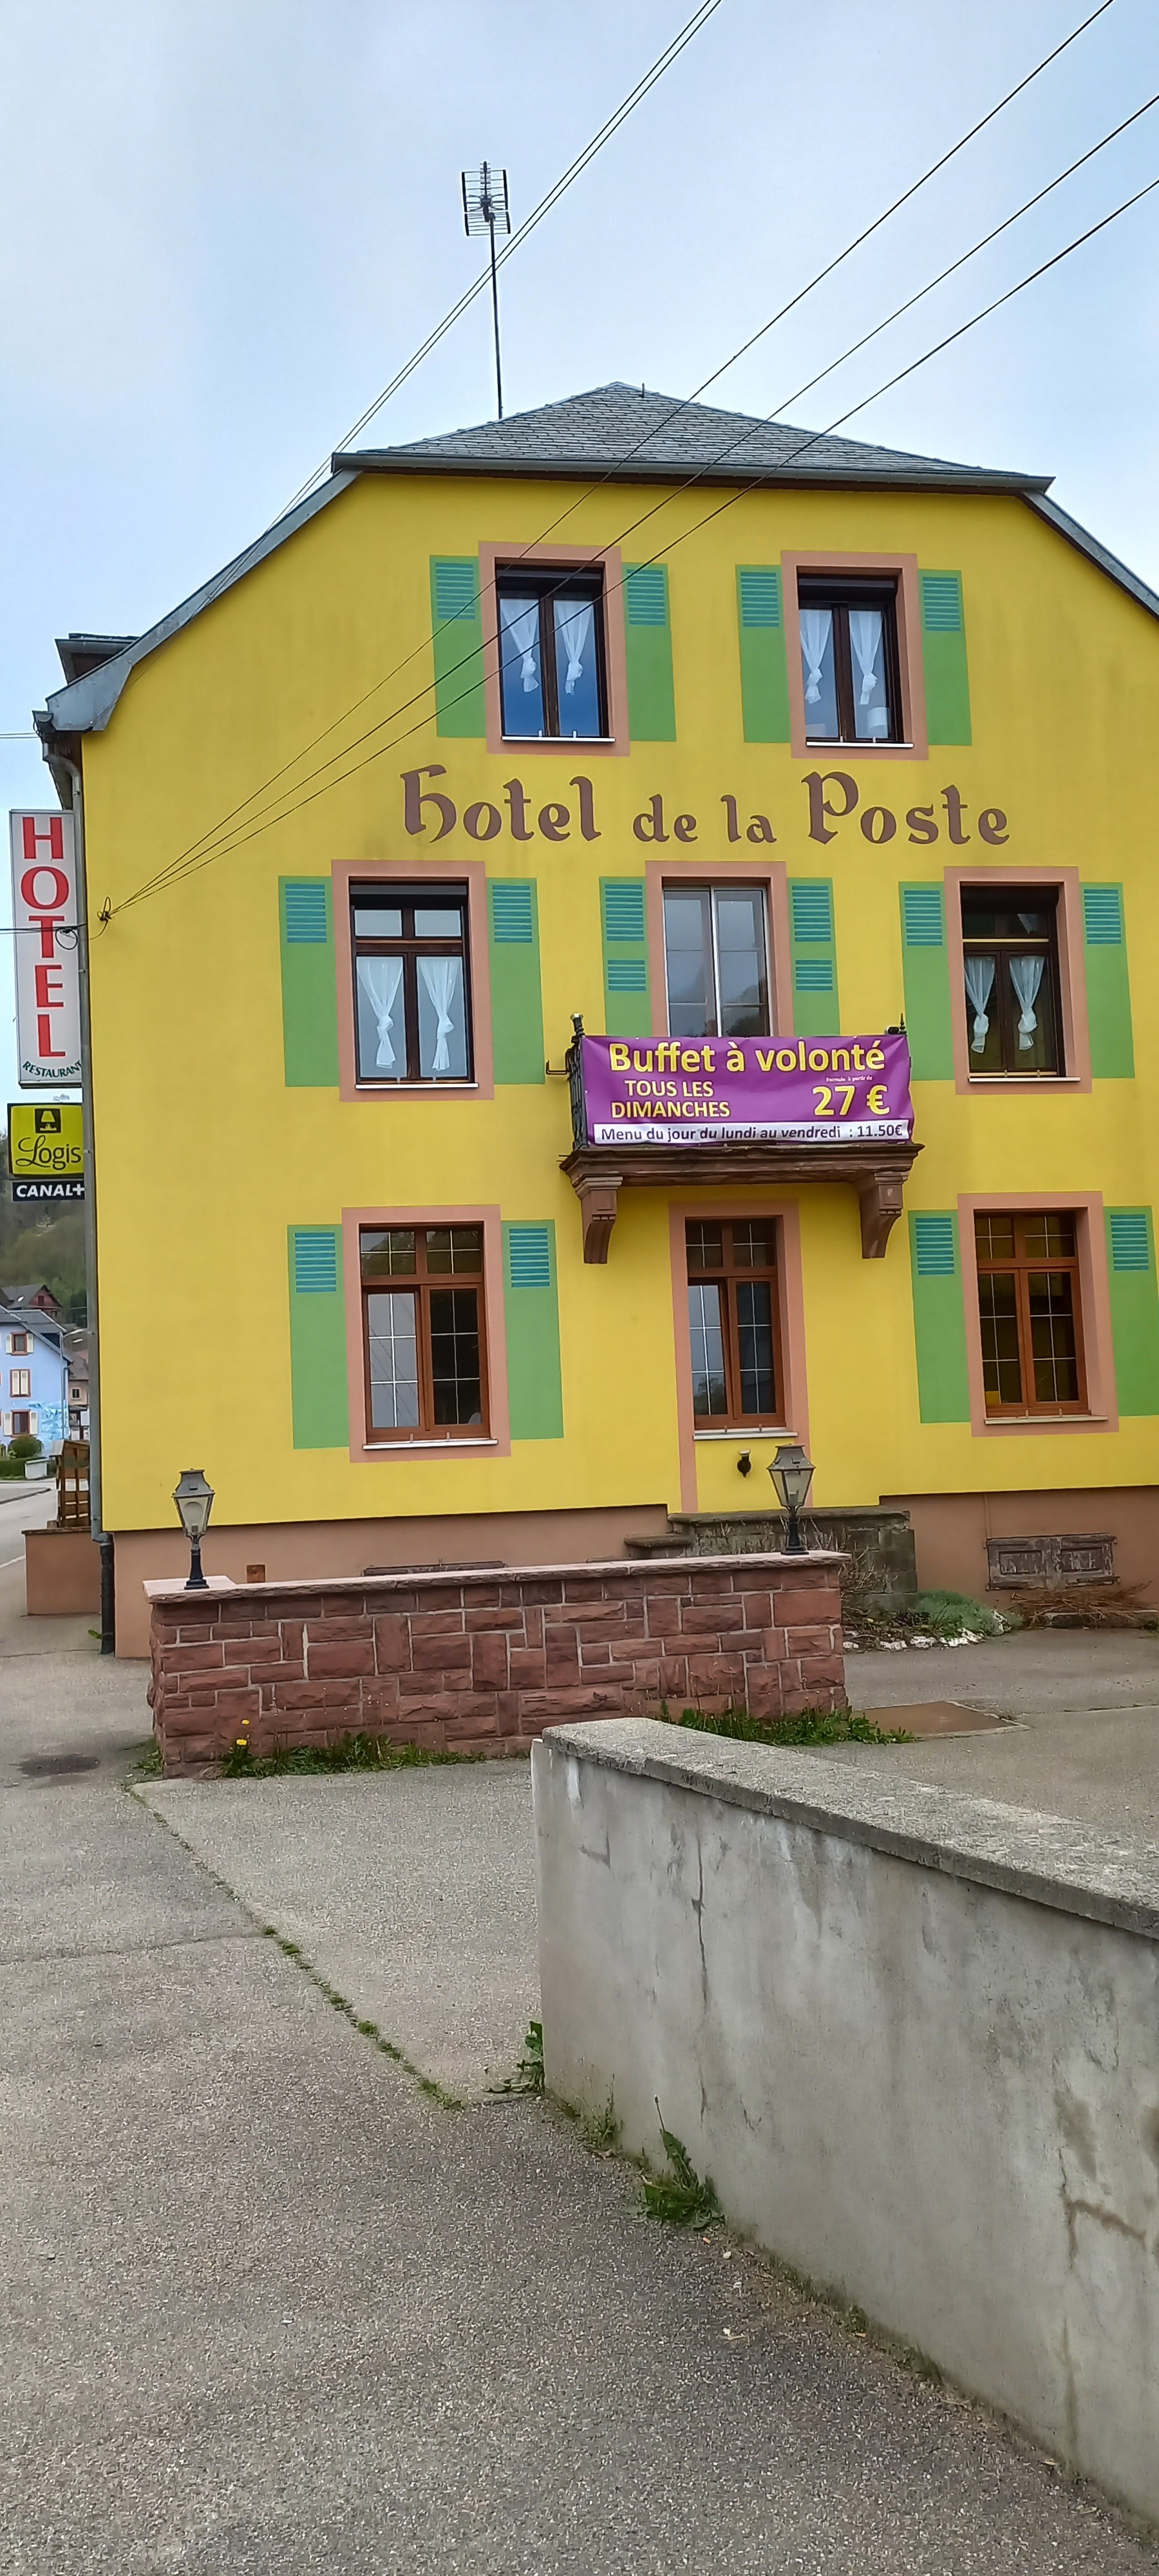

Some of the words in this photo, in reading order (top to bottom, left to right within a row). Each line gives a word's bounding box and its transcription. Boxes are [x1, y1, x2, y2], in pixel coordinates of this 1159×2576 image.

[401, 763, 602, 844] Hotel
[633, 794, 699, 843] de
[721, 794, 777, 844] la
[801, 770, 1011, 846] Poste
[20, 816, 70, 1057] HOTEL
[608, 1039, 715, 1073] Buffet
[726, 1041, 745, 1072] à
[755, 1038, 886, 1072] volonté
[23, 1060, 82, 1077] RESTAURANT
[625, 1080, 677, 1097] TOUS
[683, 1080, 713, 1097] LES
[812, 1085, 856, 1116] 27
[866, 1084, 890, 1115] €
[611, 1101, 731, 1119] DIMANCHES
[601, 1128, 643, 1141] Menu
[646, 1127, 664, 1140] du
[667, 1127, 696, 1142] jour
[700, 1127, 717, 1139] du
[721, 1126, 757, 1139] lundi
[760, 1129, 777, 1138] au
[781, 1126, 841, 1138] vendredi
[857, 1124, 903, 1137] 11.50€
[15, 1135, 82, 1171] Logis
[16, 1183, 86, 1198] CANAL+
